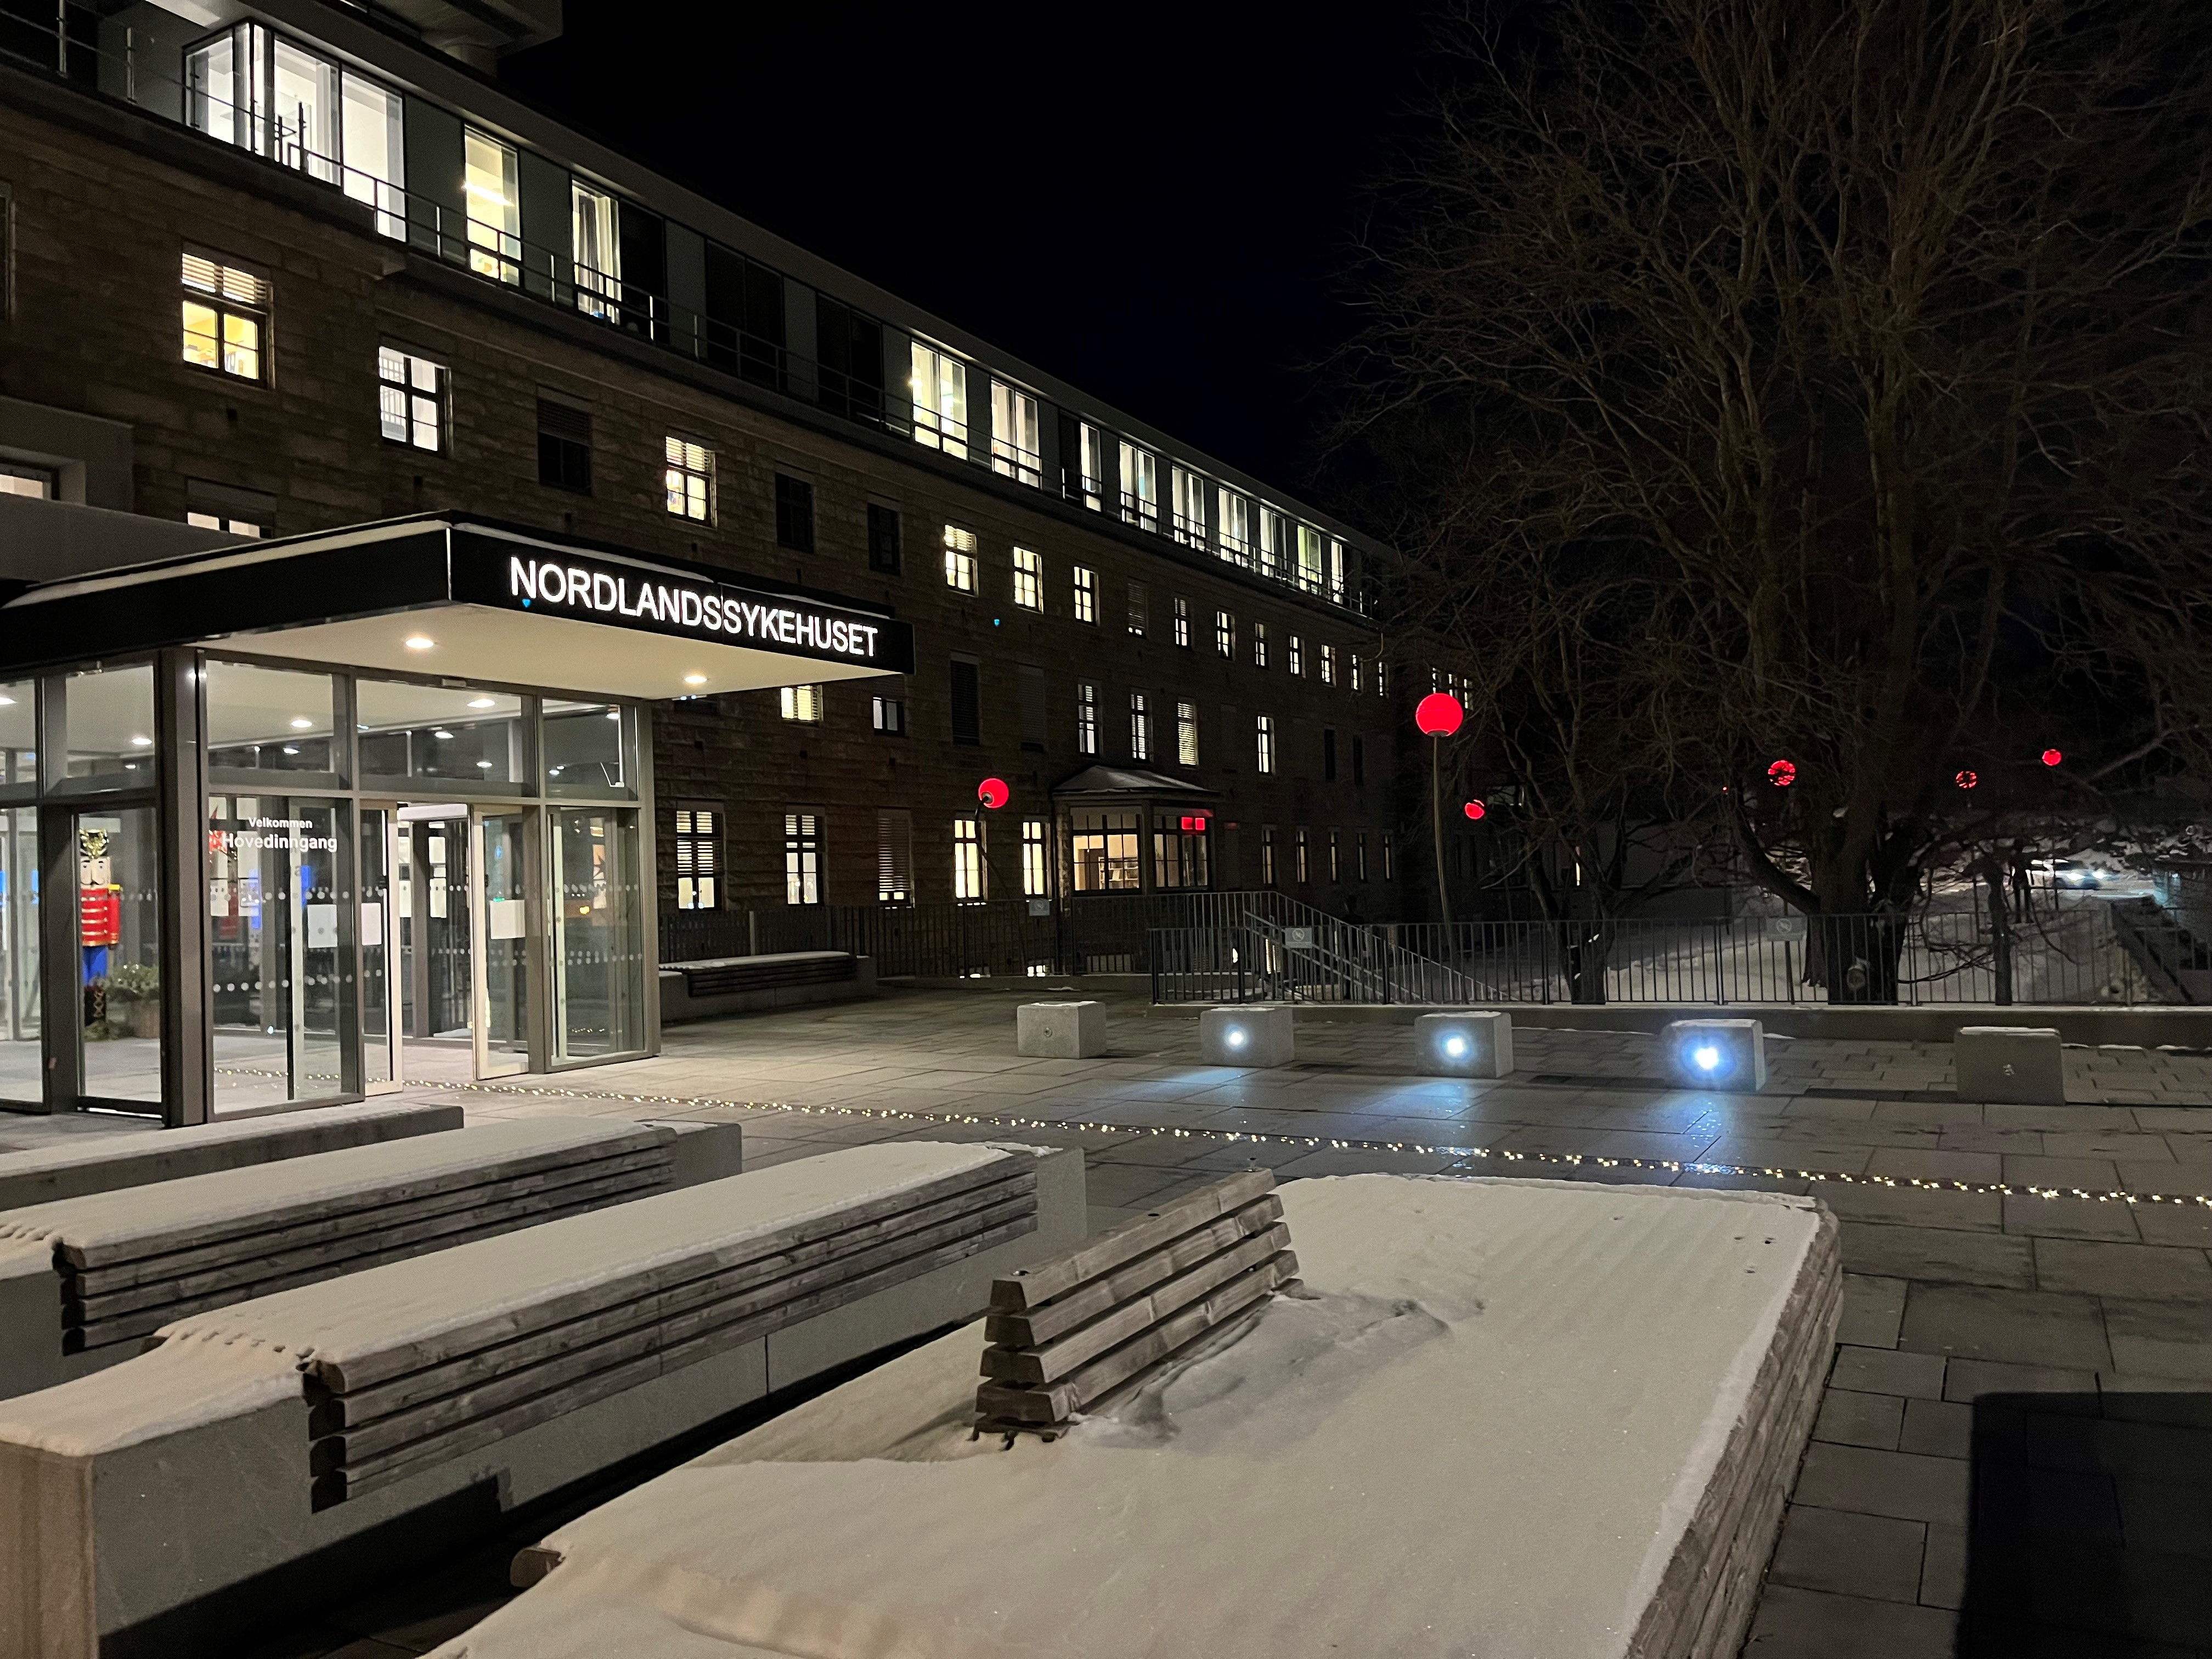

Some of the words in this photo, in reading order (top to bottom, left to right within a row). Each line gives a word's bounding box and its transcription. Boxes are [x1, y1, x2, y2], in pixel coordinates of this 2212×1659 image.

[510, 556, 879, 657] NORDLANDSSYKEHUSET
[248, 817, 313, 828] Velkommen
[222, 833, 337, 853] Hovedinngang
